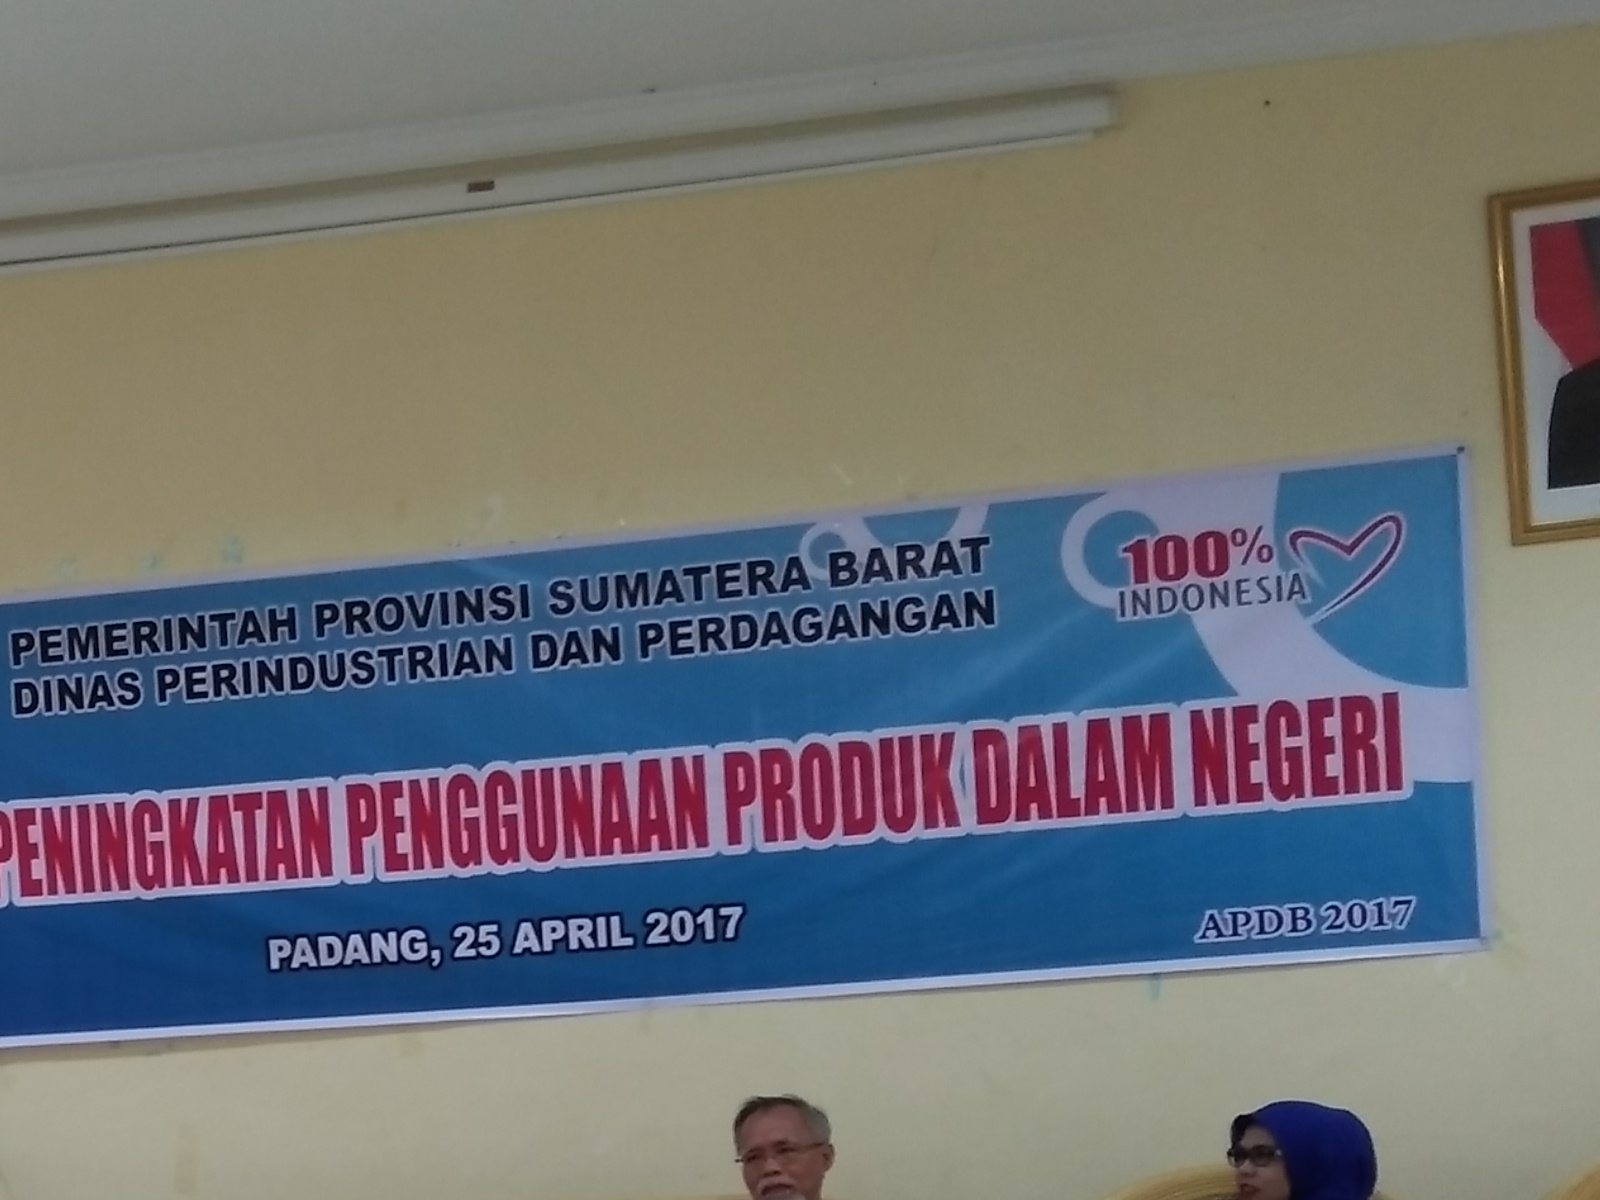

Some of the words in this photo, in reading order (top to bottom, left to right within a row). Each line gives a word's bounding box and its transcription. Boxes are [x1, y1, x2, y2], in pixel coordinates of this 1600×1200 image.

[1122, 525, 1274, 585] 100%
[11, 606, 298, 666] PEMERINTAH
[315, 584, 531, 637] PROVINSI
[549, 555, 812, 616] SUMATERA
[829, 536, 991, 588] BARAT
[1118, 572, 1306, 618] INDONESIA
[13, 671, 141, 717] DINAS
[157, 637, 513, 704] PERINDUSTRIAN
[531, 626, 621, 670] DAN
[638, 589, 997, 660] PERDAGANGAN
[345, 754, 709, 876] PENGGUNAAN
[723, 731, 960, 846] PRODUK
[972, 712, 1175, 826] DALAM
[1190, 691, 1404, 808] NEGERI
[268, 928, 443, 971] PADANG,
[453, 923, 500, 959] 25
[513, 915, 634, 953] APRIL
[645, 905, 745, 946] 2017
[1200, 907, 1314, 941] APDB
[1327, 898, 1417, 931] 2017
